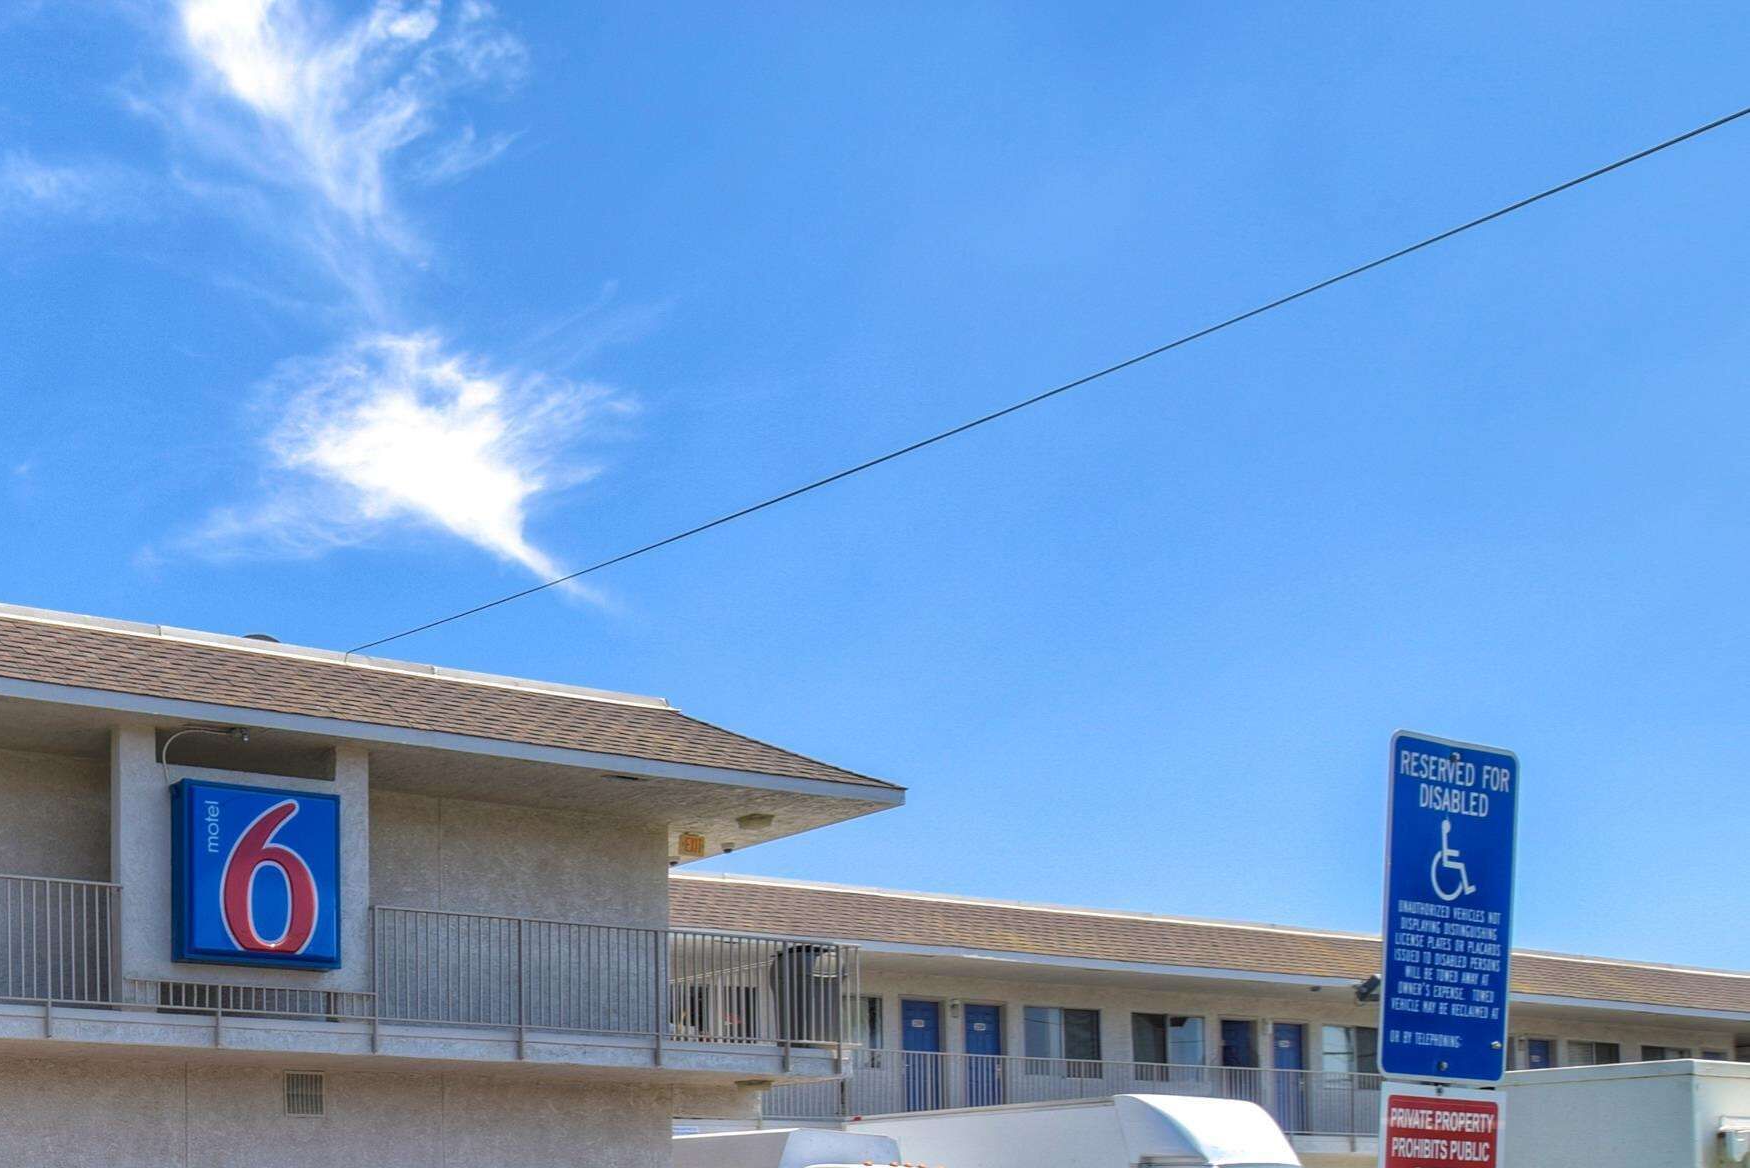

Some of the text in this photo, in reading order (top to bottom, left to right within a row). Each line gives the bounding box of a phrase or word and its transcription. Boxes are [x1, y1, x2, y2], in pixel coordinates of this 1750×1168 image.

[1400, 750, 1510, 793] RESERVED FOR
[1419, 784, 1489, 818] DISABLED
[205, 800, 220, 853] motel
[219, 798, 319, 955] 6
[1453, 907, 1485, 923] VEHICLES
[1394, 932, 1501, 957] LICENSE PLATES OR PLACARDS
[1422, 951, 1432, 964] TO
[1434, 953, 1467, 968] DISABLED
[1470, 957, 1501, 972] PERSONS
[1405, 965, 1490, 986] WILL BE TOWED AWAY AT
[1397, 980, 1430, 997] OWNER'S
[1472, 989, 1495, 1003] TOWED
[1391, 997, 1500, 1020] VEHICLE MAY BE RECLAIMED AT
[1390, 1029, 1400, 1043] OR
[1403, 1031, 1412, 1044] BY
[1389, 1107, 1495, 1134] PRIVATE PROPERTY
[1391, 1137, 1490, 1162] PROHIBITS PUBLIC
